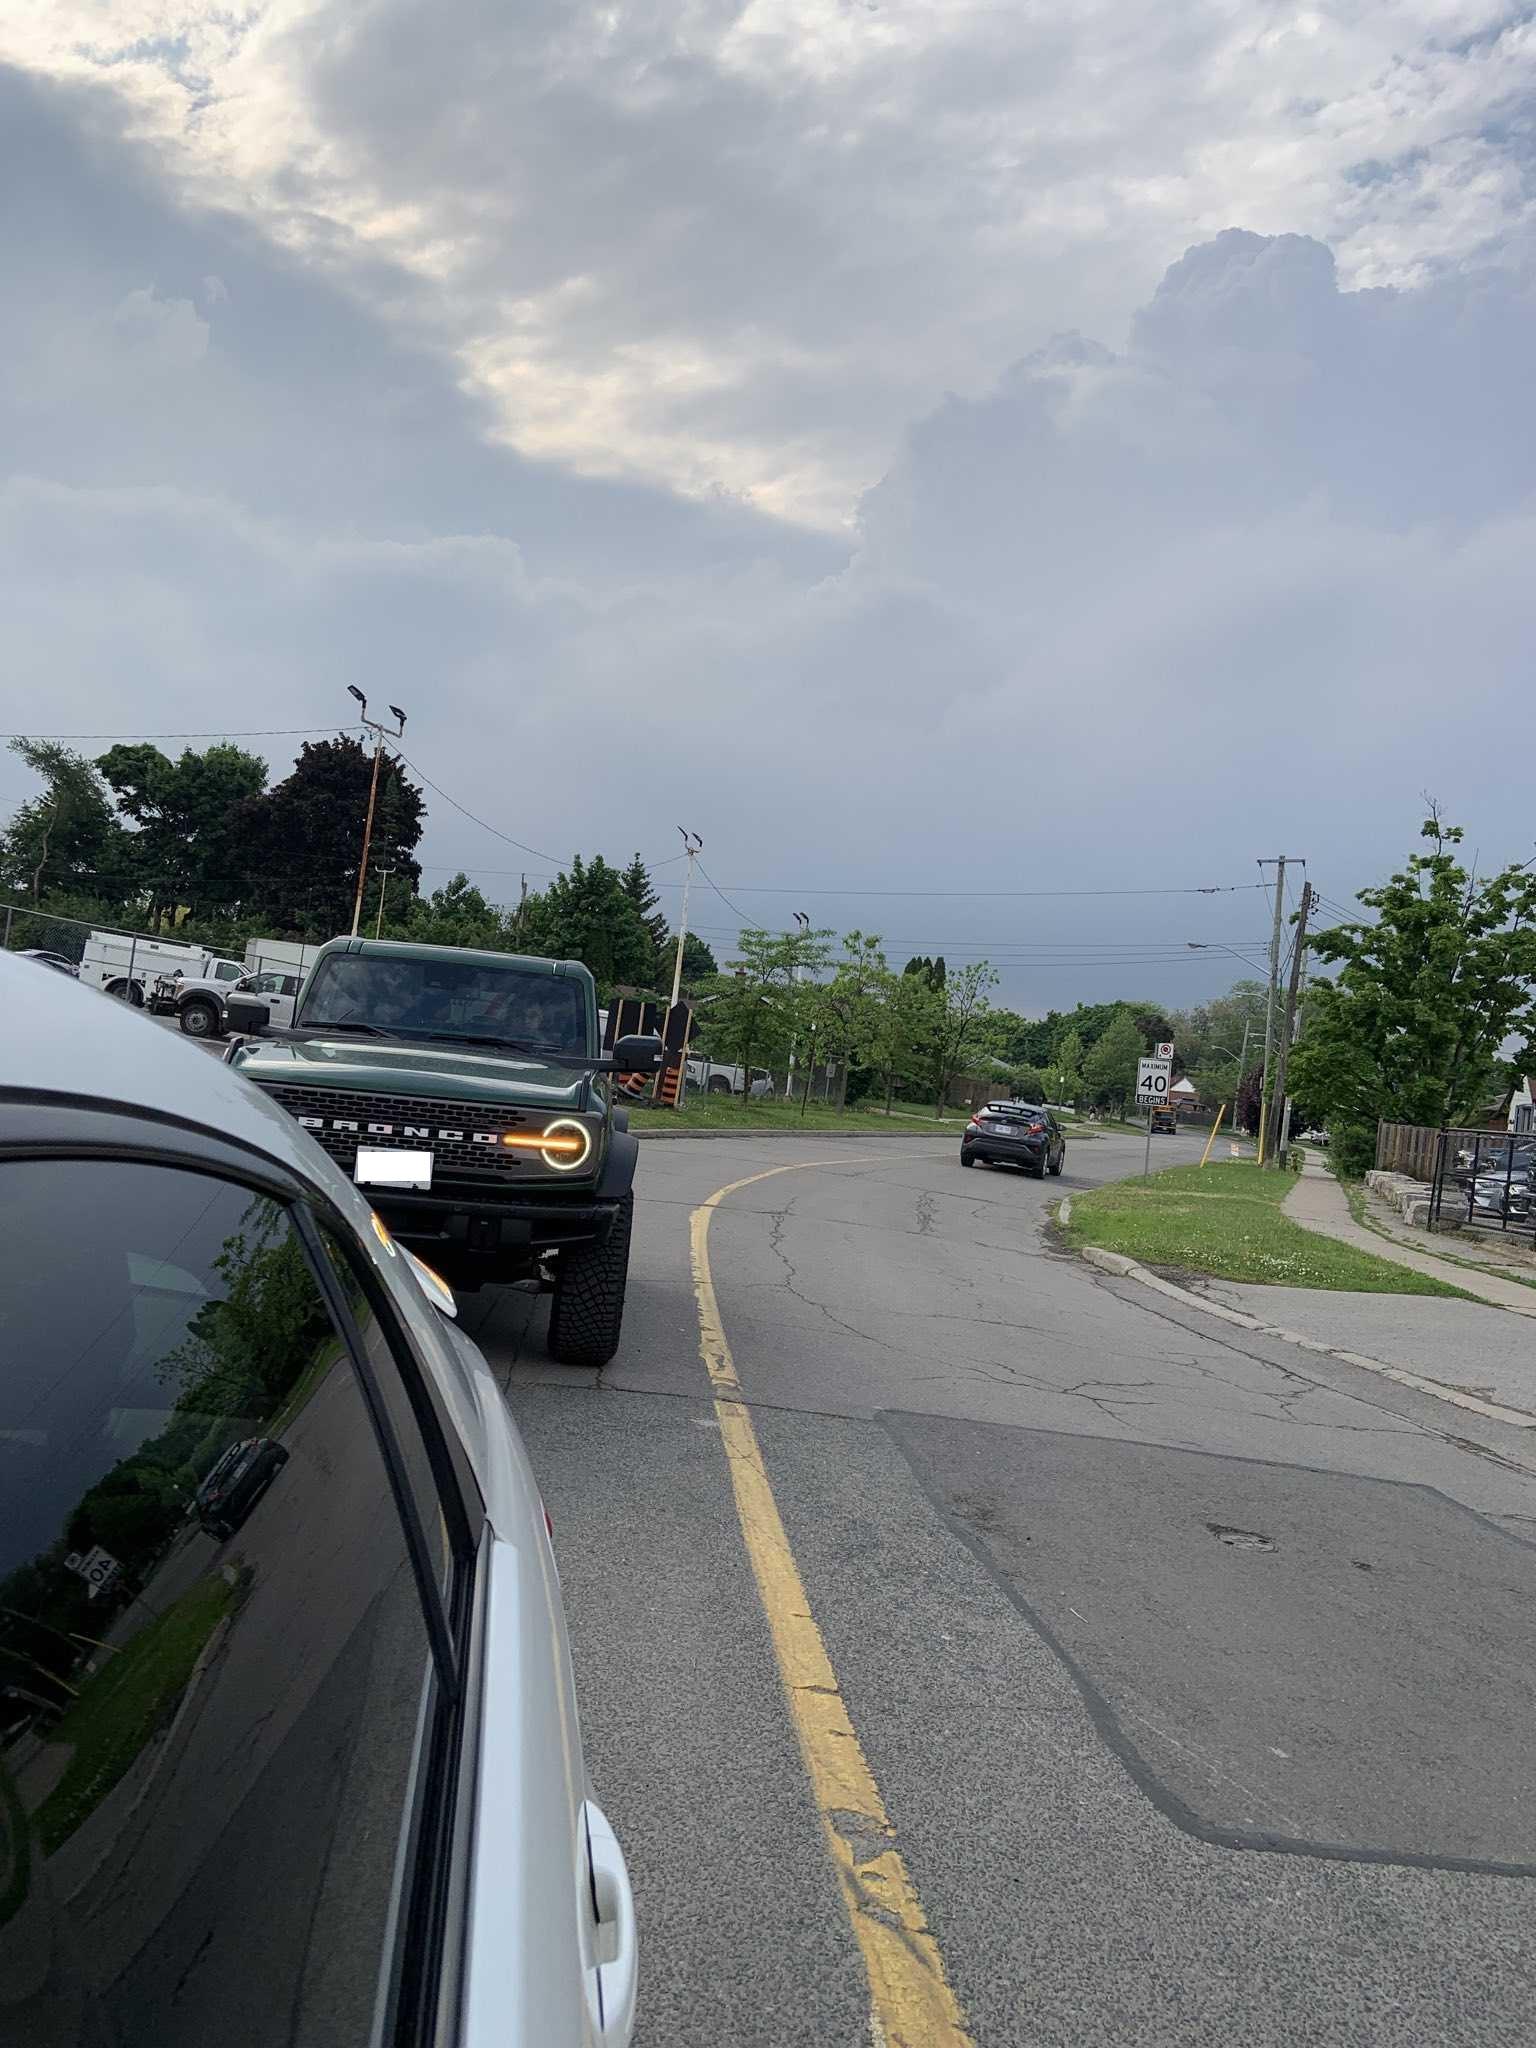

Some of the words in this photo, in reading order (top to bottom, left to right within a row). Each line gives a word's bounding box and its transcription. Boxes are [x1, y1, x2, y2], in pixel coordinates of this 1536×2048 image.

[1141, 1075, 1167, 1092] 40
[1138, 1095, 1165, 1104] BEGINS
[298, 1116, 498, 1144] BRONCO
